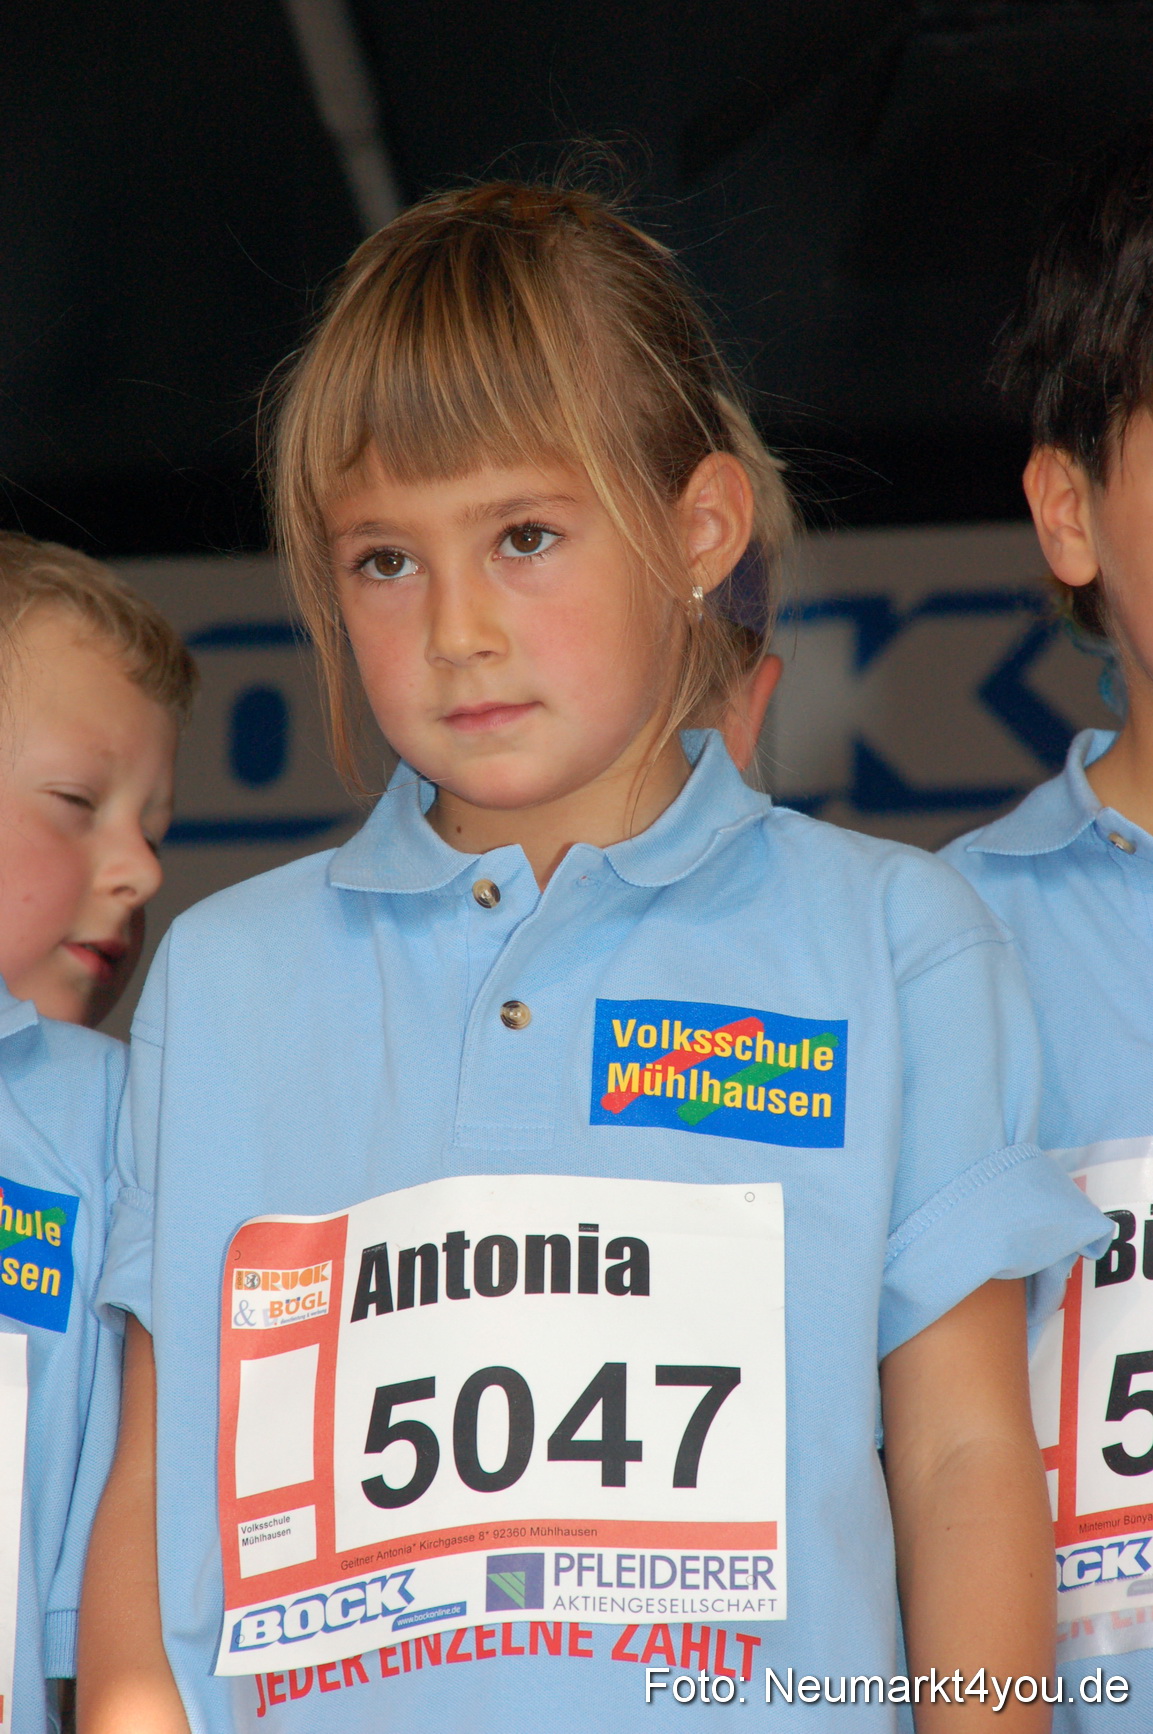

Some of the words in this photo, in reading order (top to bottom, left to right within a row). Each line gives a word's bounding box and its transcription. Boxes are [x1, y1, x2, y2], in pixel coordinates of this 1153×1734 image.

[612, 1018, 834, 1071] Volksschule
[607, 1062, 832, 1118] Mühlhausen
[235, 1263, 330, 1291] DRUCK
[350, 1223, 651, 1323] Antonia
[269, 1291, 328, 1319] BÖGL
[361, 1362, 741, 1509] 5047
[241, 1515, 291, 1534] Volksschule
[241, 1527, 291, 1547] Mühlhausen
[340, 1554, 375, 1571] Geitner
[420, 1534, 475, 1551] Kirchgasse
[493, 1527, 527, 1540] 92360
[530, 1526, 598, 1537] Mühlhausen
[554, 1552, 778, 1591] PFLEIDERER
[229, 1568, 415, 1653] BOCK
[552, 1595, 778, 1614] AKTIENGESELLSCHAFT
[378, 1621, 594, 1679] EINZELNE
